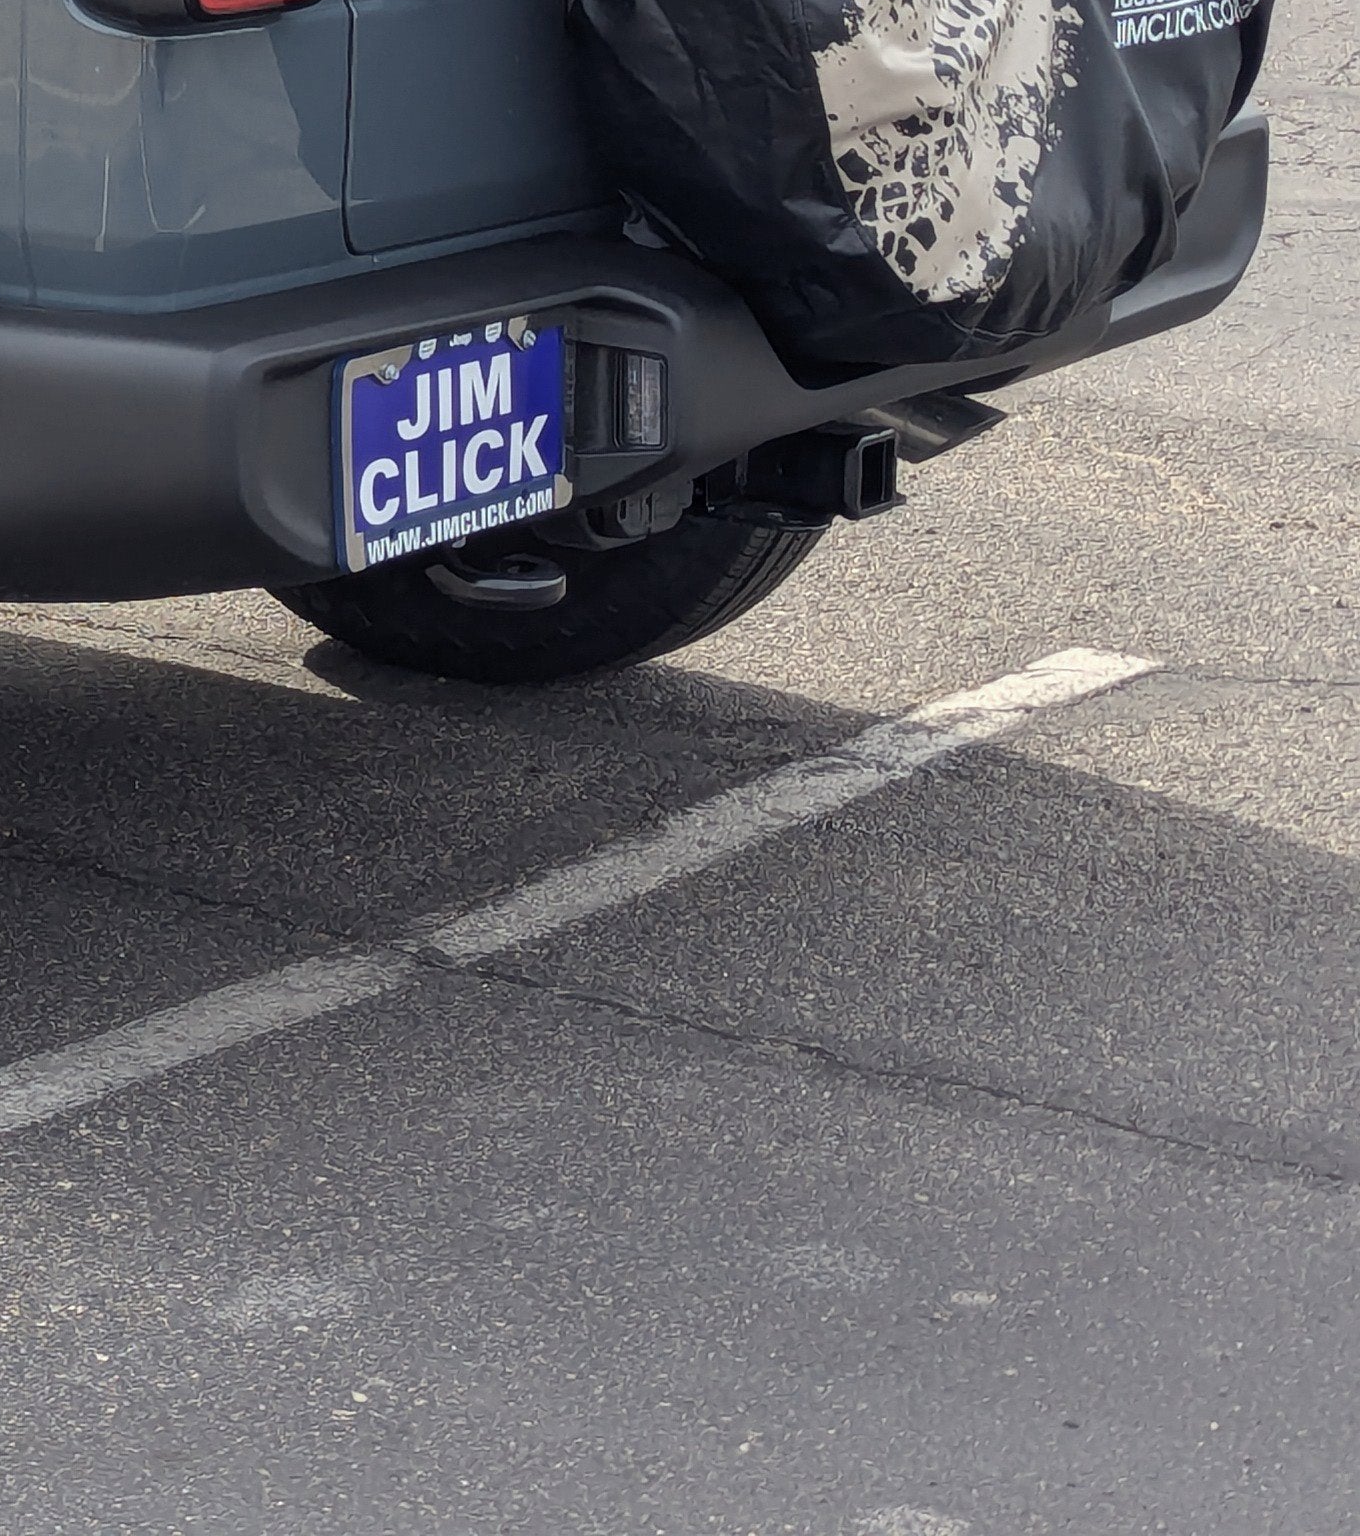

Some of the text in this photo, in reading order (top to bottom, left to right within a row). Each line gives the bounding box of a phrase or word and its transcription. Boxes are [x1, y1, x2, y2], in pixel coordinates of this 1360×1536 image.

[397, 352, 512, 442] JIM
[359, 413, 550, 526] CLICK
[366, 486, 554, 566] WWW.JIMCLICK.COM
